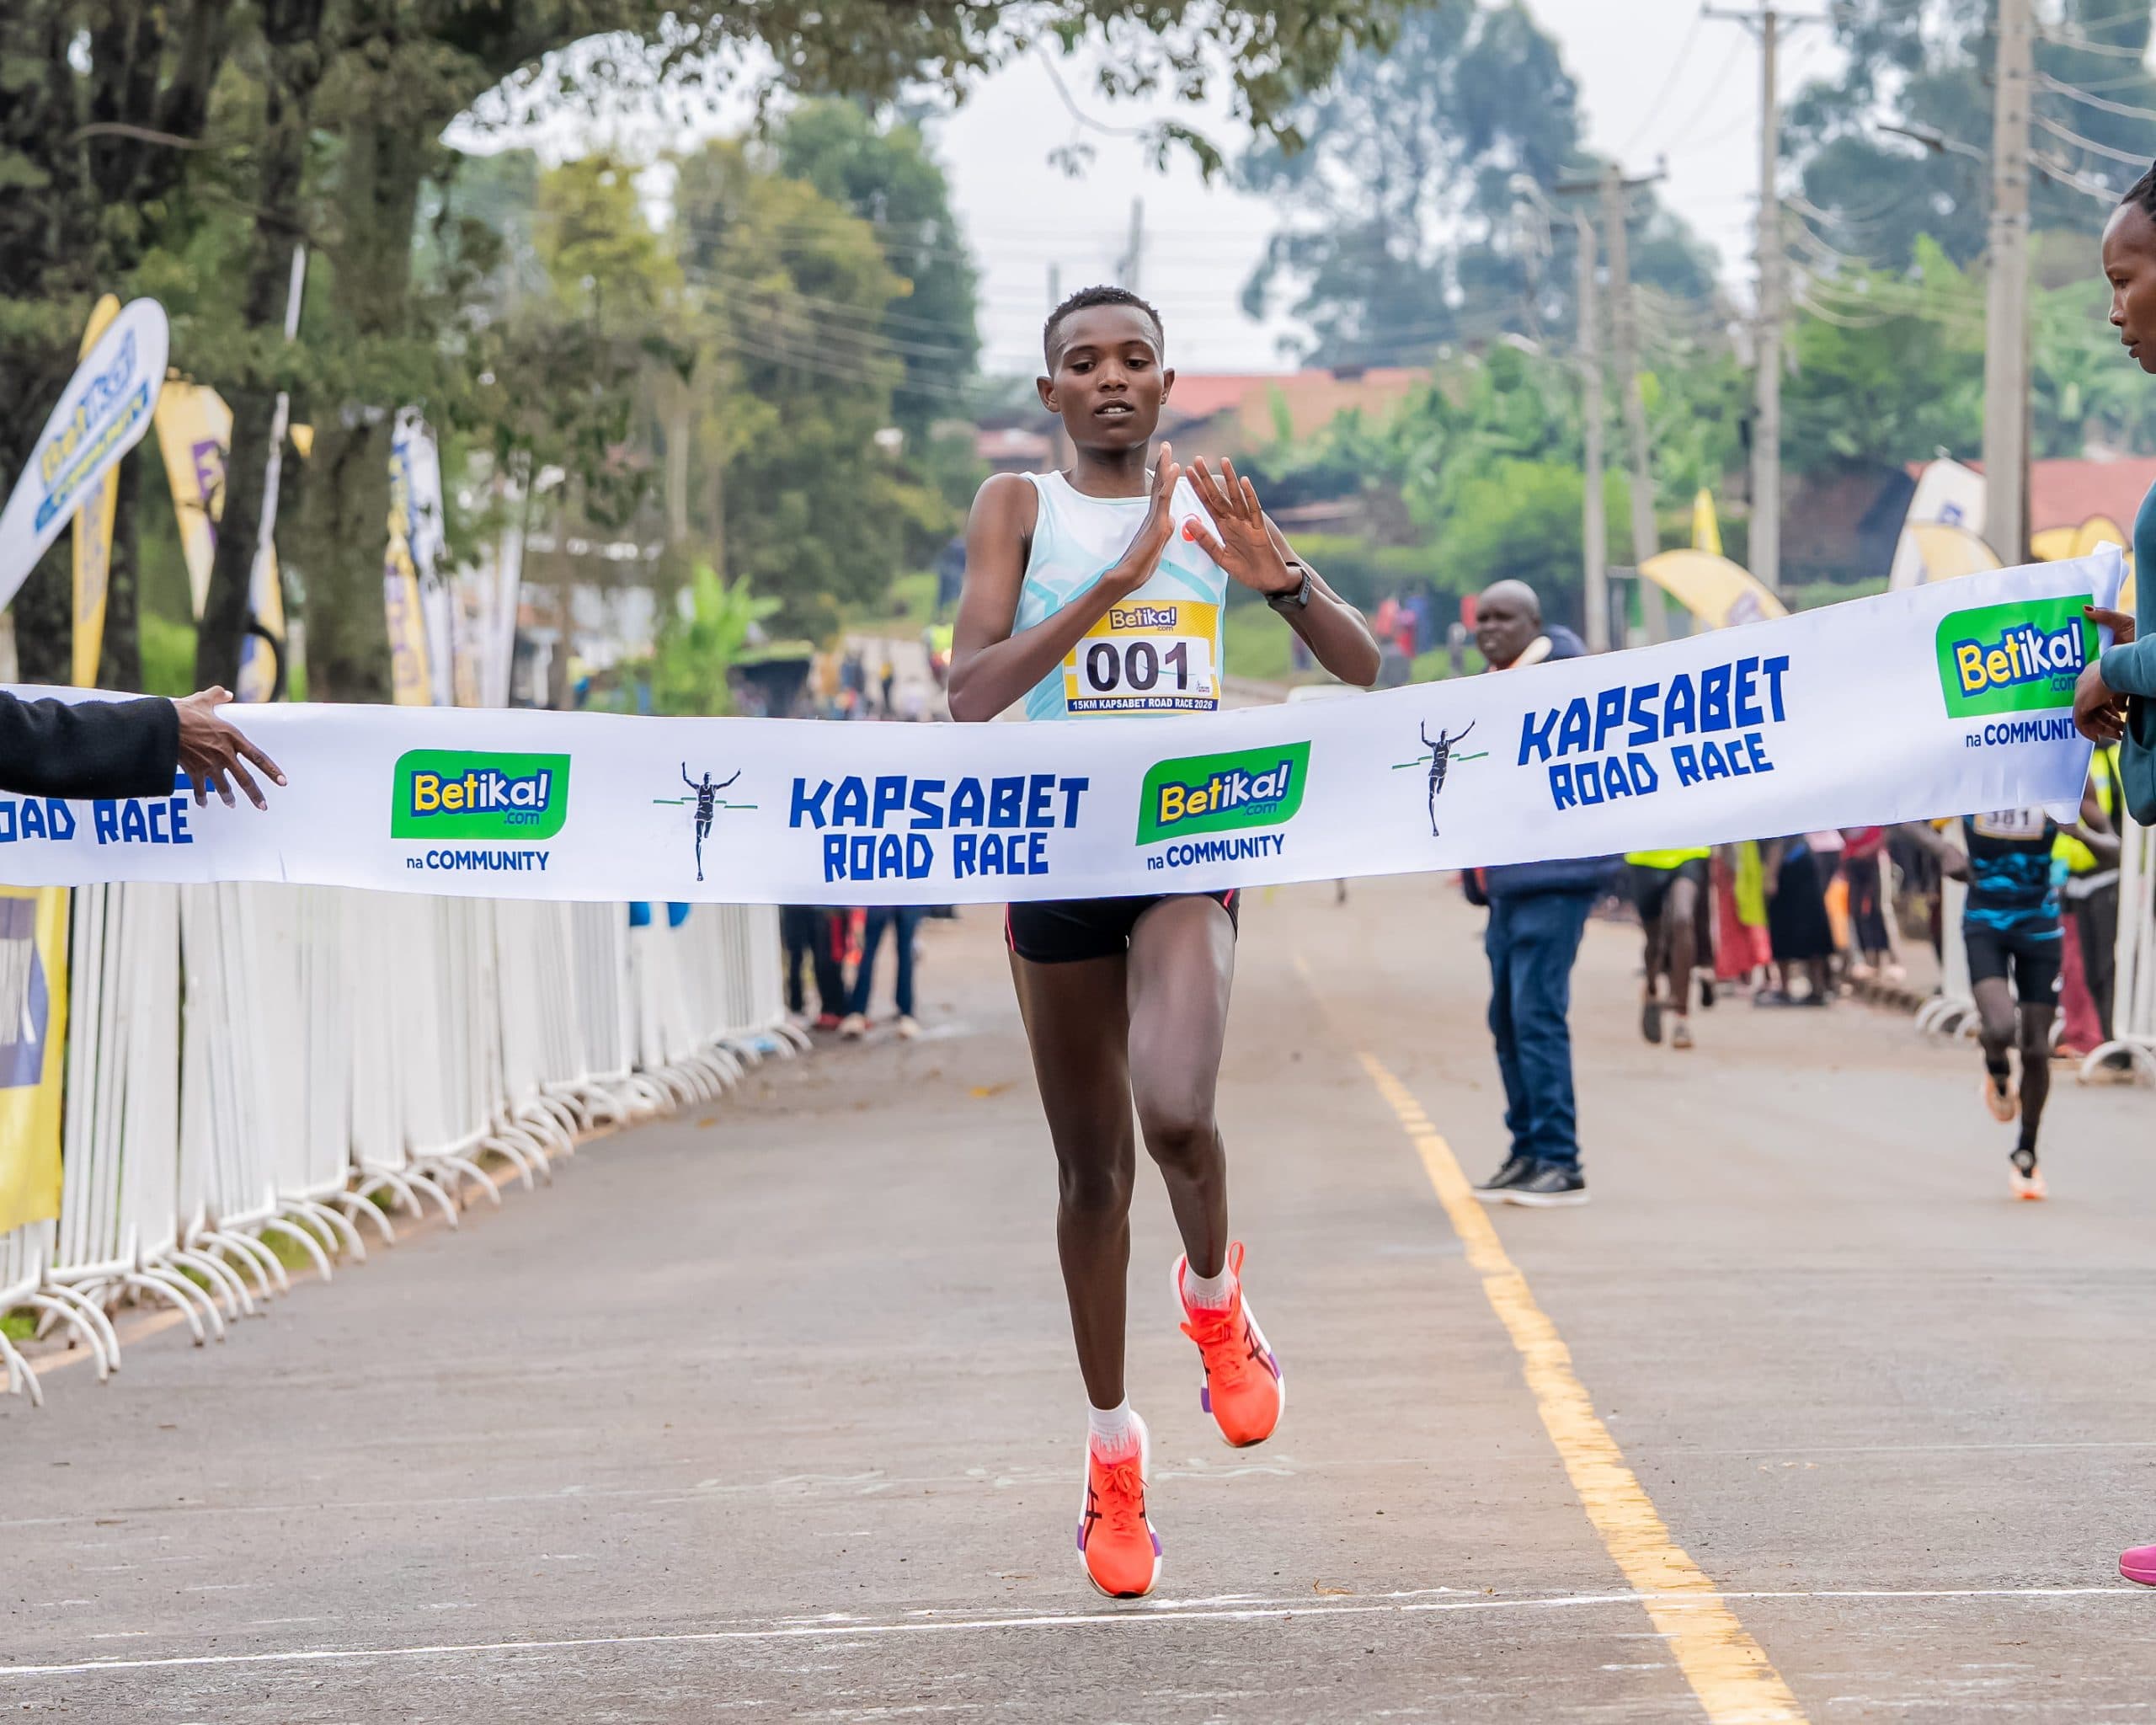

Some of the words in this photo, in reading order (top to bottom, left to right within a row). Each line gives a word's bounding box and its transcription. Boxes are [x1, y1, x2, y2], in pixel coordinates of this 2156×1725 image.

[1112, 607, 1177, 629] Betika!
[1086, 642, 1187, 692] 001
[1956, 623, 2082, 692] Betika!
[1073, 699, 1097, 710] 15KM
[1099, 698, 1145, 709] KAPSABET
[1149, 697, 1172, 708] ROAD
[1175, 698, 1193, 708] RACE
[1194, 699, 1213, 710] 2026
[1518, 655, 1790, 766] KAPSABET
[1967, 733, 1982, 747] na
[1984, 718, 2076, 745] COMMUNIT
[414, 772, 548, 811] Betika!
[1549, 752, 1658, 810] ROAD
[1671, 733, 1774, 787] RACE
[789, 774, 1089, 830] KAPSABET
[1160, 764, 1289, 823] Betika!
[1243, 802, 1278, 816] .com
[0, 797, 76, 842] OAD
[93, 798, 194, 844] RACE
[504, 811, 540, 825] .com
[407, 857, 424, 869] na
[426, 850, 549, 870] COMMUNITY
[824, 832, 934, 883] ROAD
[953, 832, 1049, 879] RACE
[1147, 856, 1164, 870] na
[1166, 833, 1284, 868] COMMUNITY
